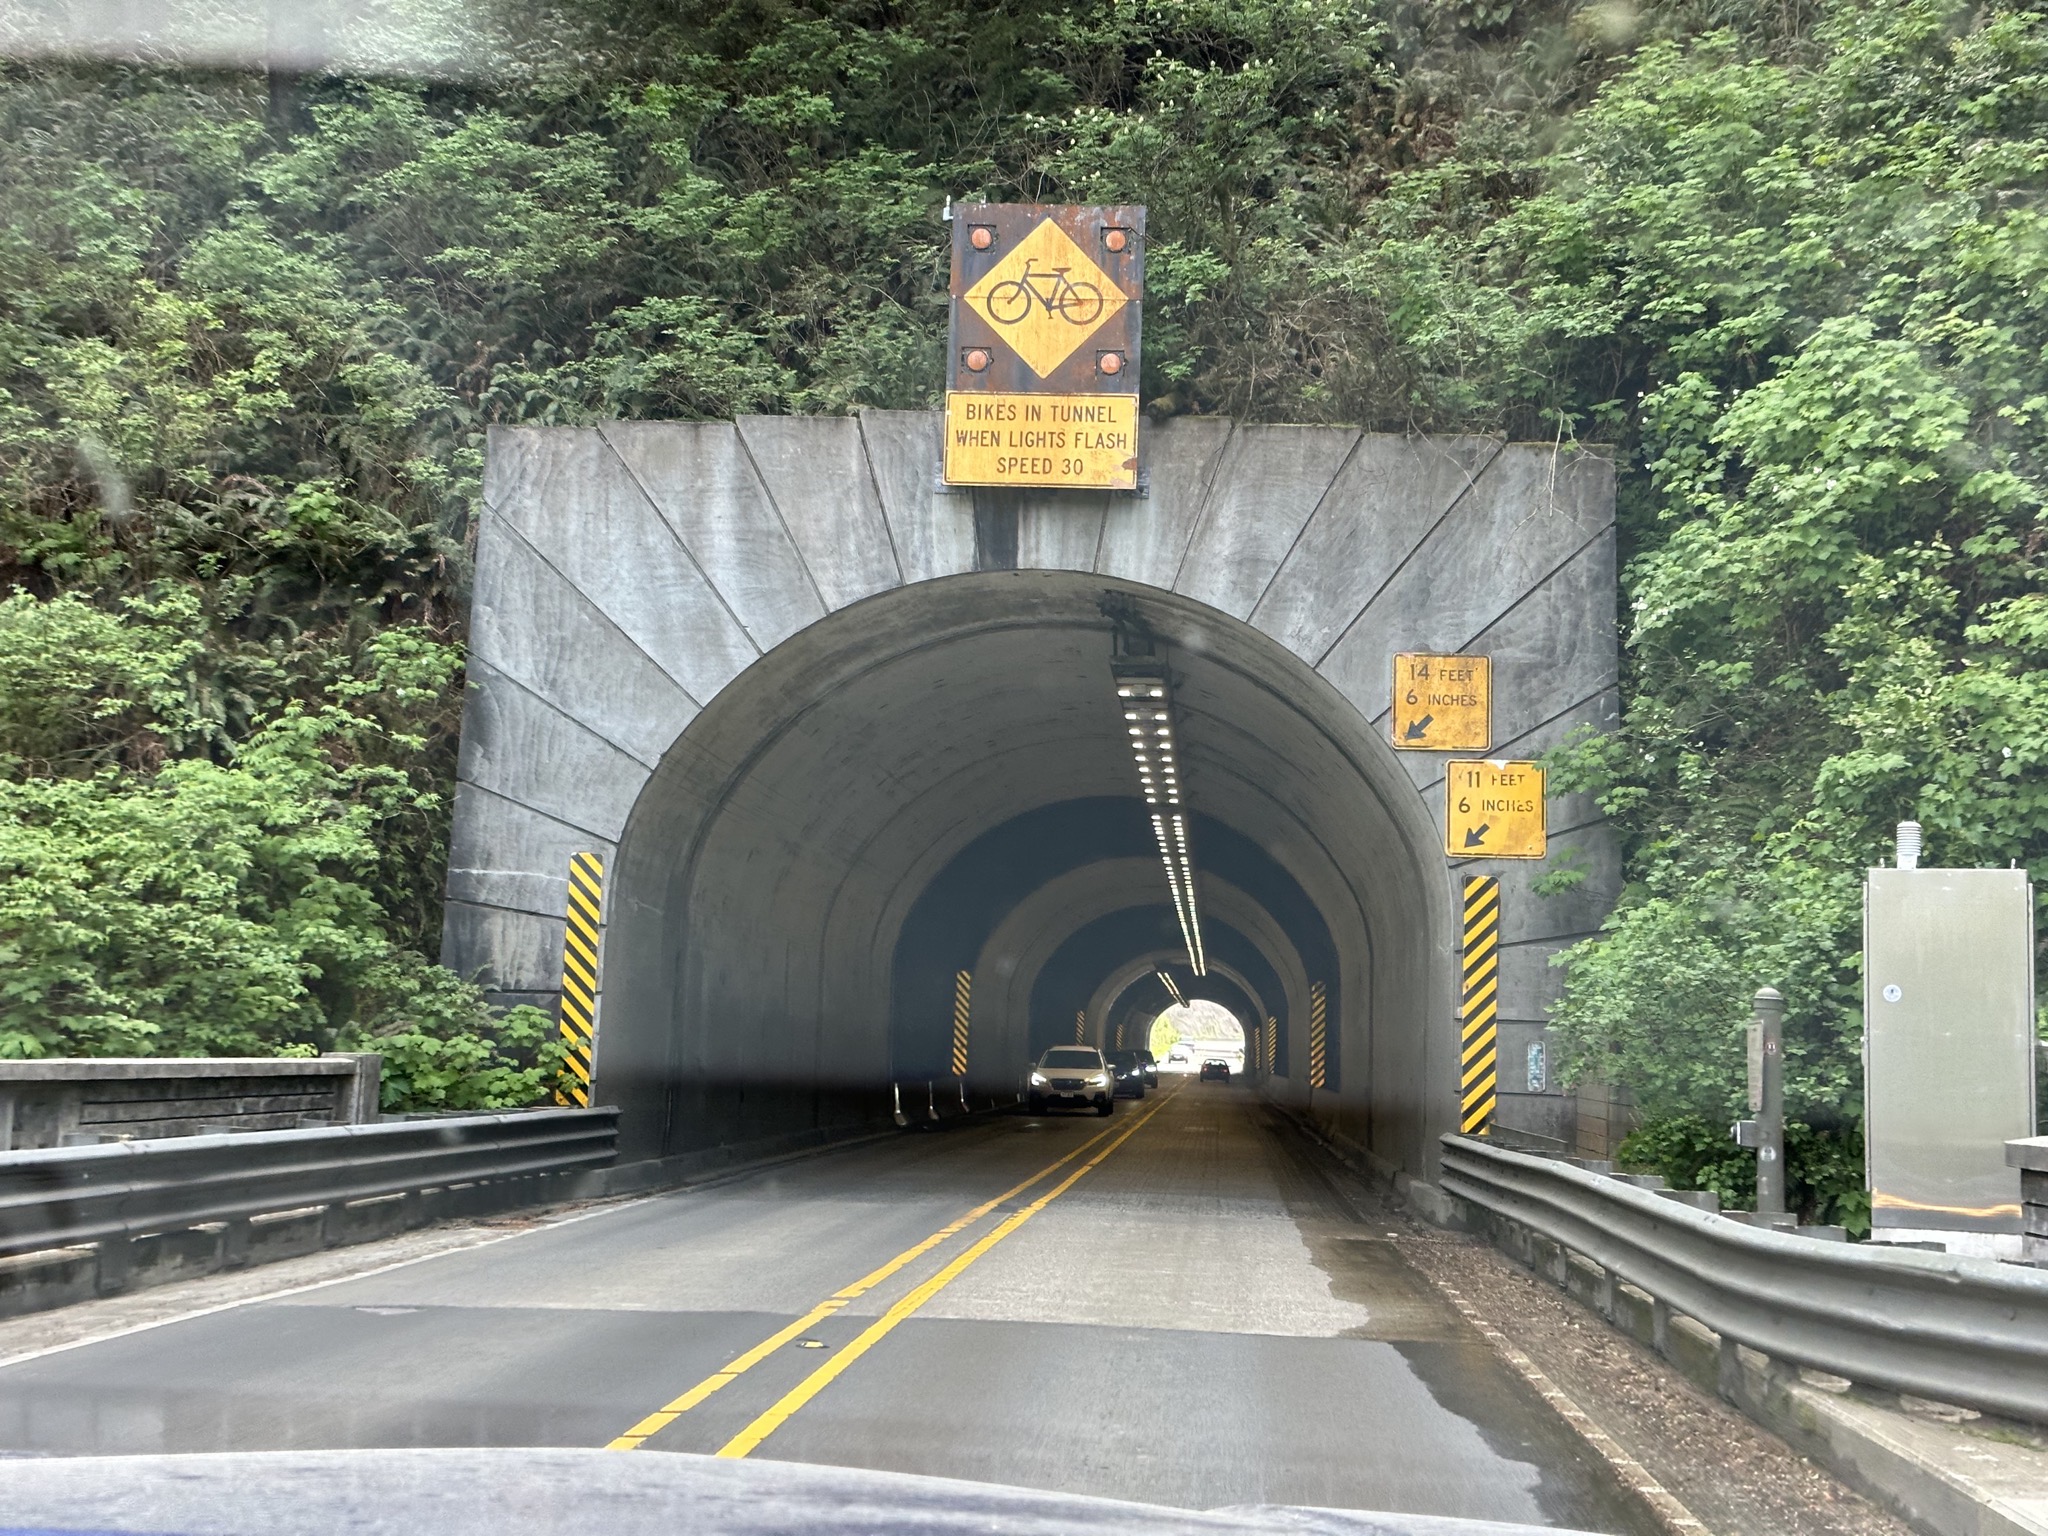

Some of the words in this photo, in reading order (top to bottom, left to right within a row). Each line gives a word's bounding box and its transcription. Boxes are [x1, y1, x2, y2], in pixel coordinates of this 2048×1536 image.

[966, 403, 1017, 421] BIKES
[1025, 404, 1042, 422] IN
[1050, 405, 1117, 423] TUNNEL
[955, 430, 1001, 447] WHEN
[1009, 431, 1066, 448] LIGHTS
[1074, 432, 1127, 449] FLASH
[996, 457, 1053, 475] SPEED
[1061, 458, 1084, 475] 30
[1409, 664, 1430, 681] 14
[1439, 669, 1474, 682] FEET
[1405, 689, 1418, 705] 6
[1428, 694, 1477, 707] INCHES
[1466, 771, 1481, 788] 11
[1458, 797, 1471, 814] 6
